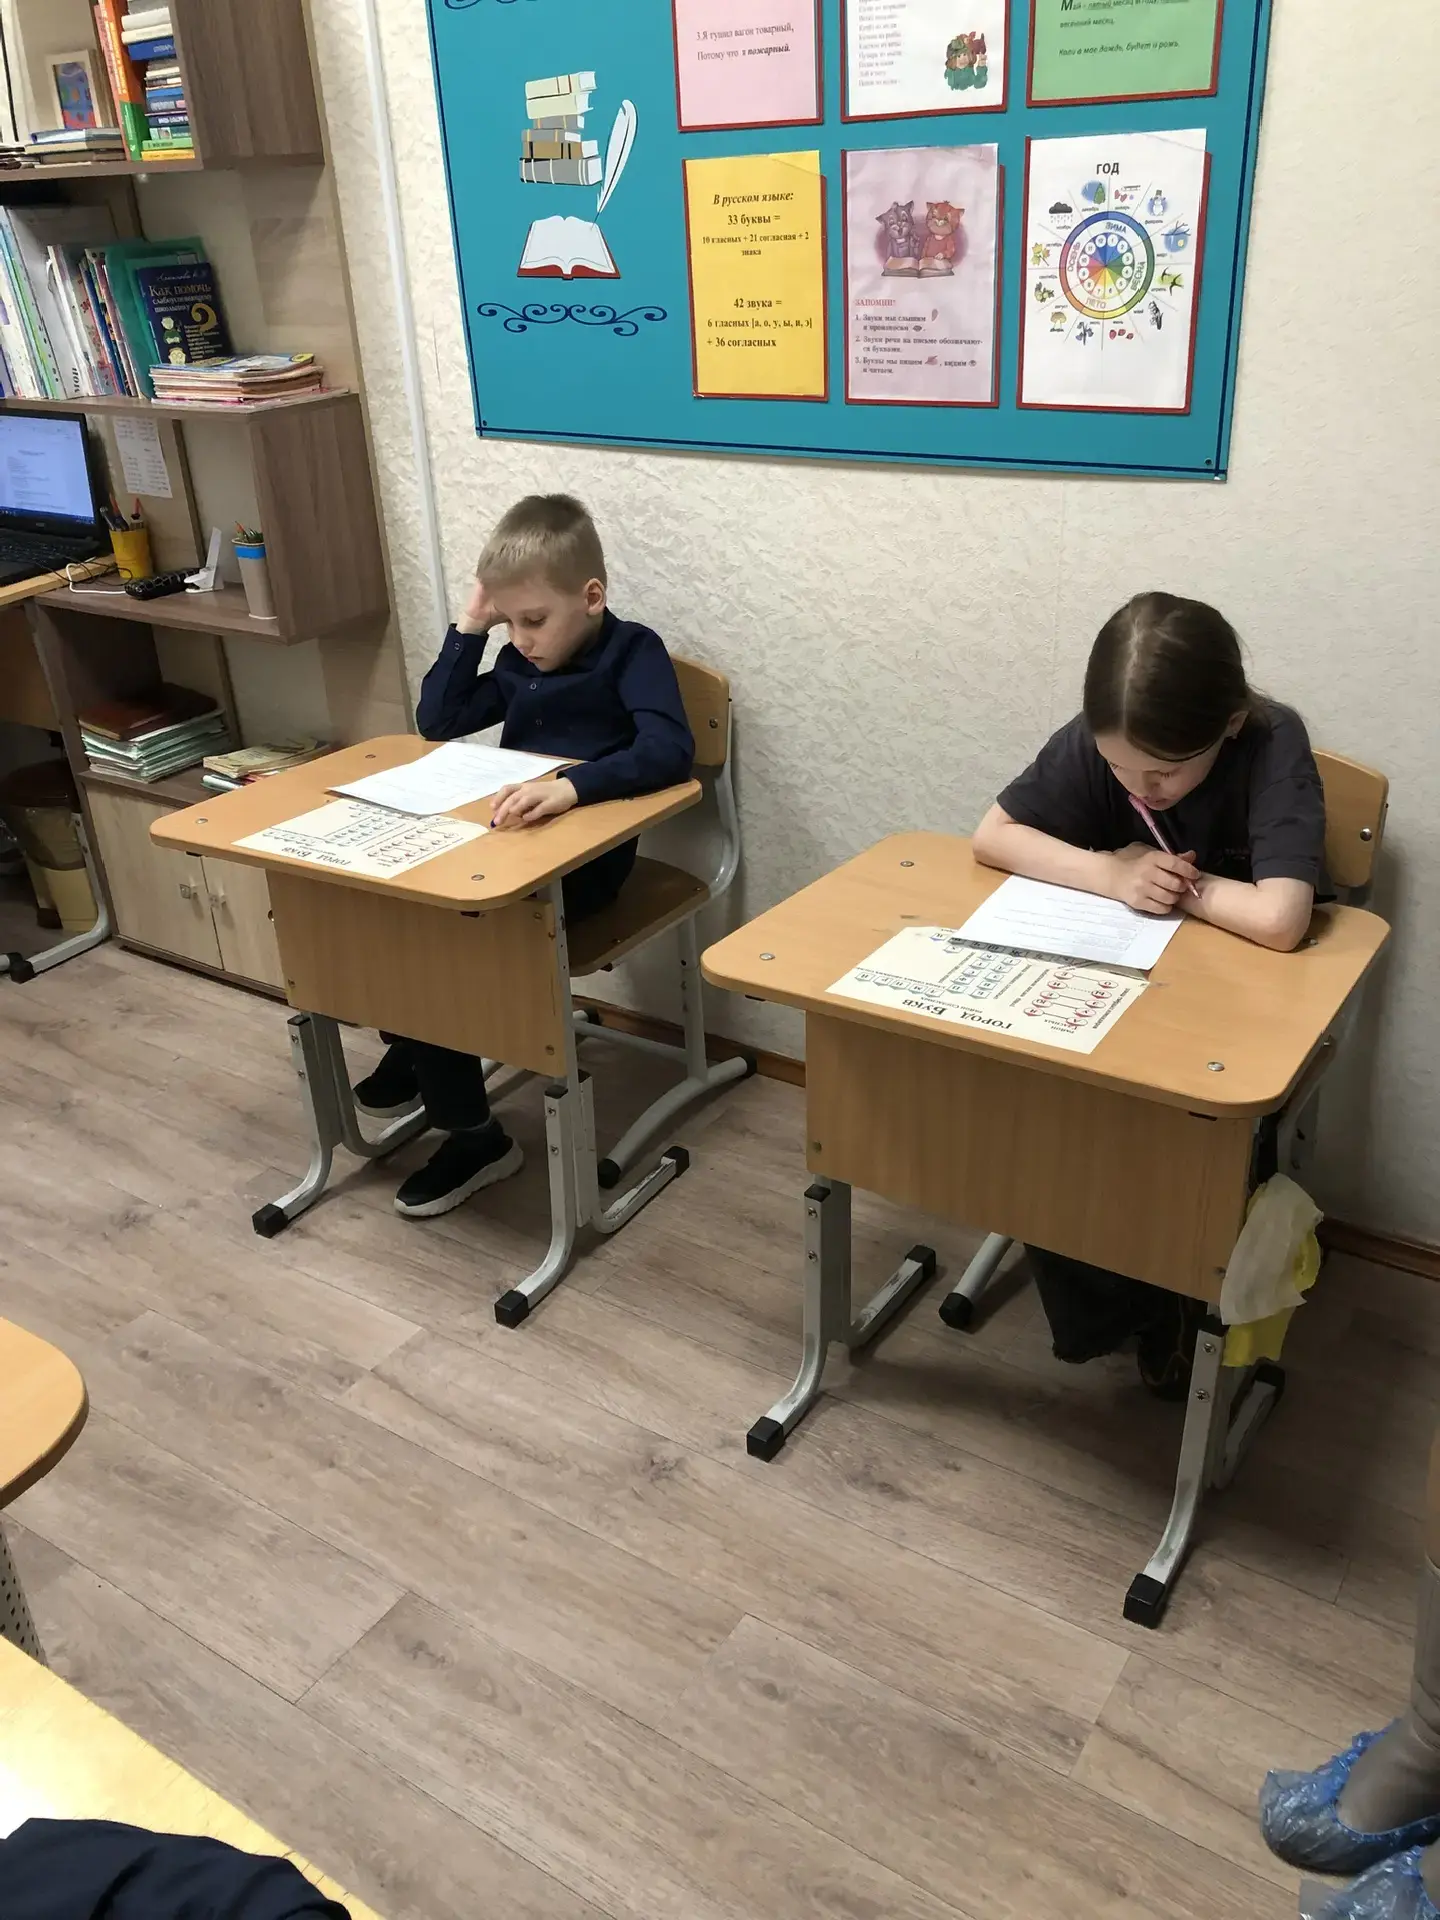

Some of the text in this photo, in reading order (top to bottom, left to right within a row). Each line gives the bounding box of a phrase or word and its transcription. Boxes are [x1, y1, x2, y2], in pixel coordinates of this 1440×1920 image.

[697, 51, 724, 60] Потому
[1096, 162, 1120, 175] ГОД
[713, 192, 793, 207] В русском языке:
[728, 215, 738, 225] 33
[740, 214, 771, 227] буквы
[1105, 222, 1127, 233] ЗИМА
[703, 236, 709, 244] 10
[750, 234, 757, 242] 21
[760, 234, 796, 242] согласная
[1130, 260, 1146, 291] ВЕСНА
[149, 284, 211, 297] Как помочь
[734, 298, 744, 308] 42
[747, 300, 772, 310] звука
[1085, 298, 1107, 309] ЛЕТО
[708, 319, 712, 327] 6
[715, 319, 749, 327] гласных
[715, 337, 725, 347] 36
[727, 338, 776, 347] согласных
[902, 999, 1012, 1030] ГОРОД БУКВ
